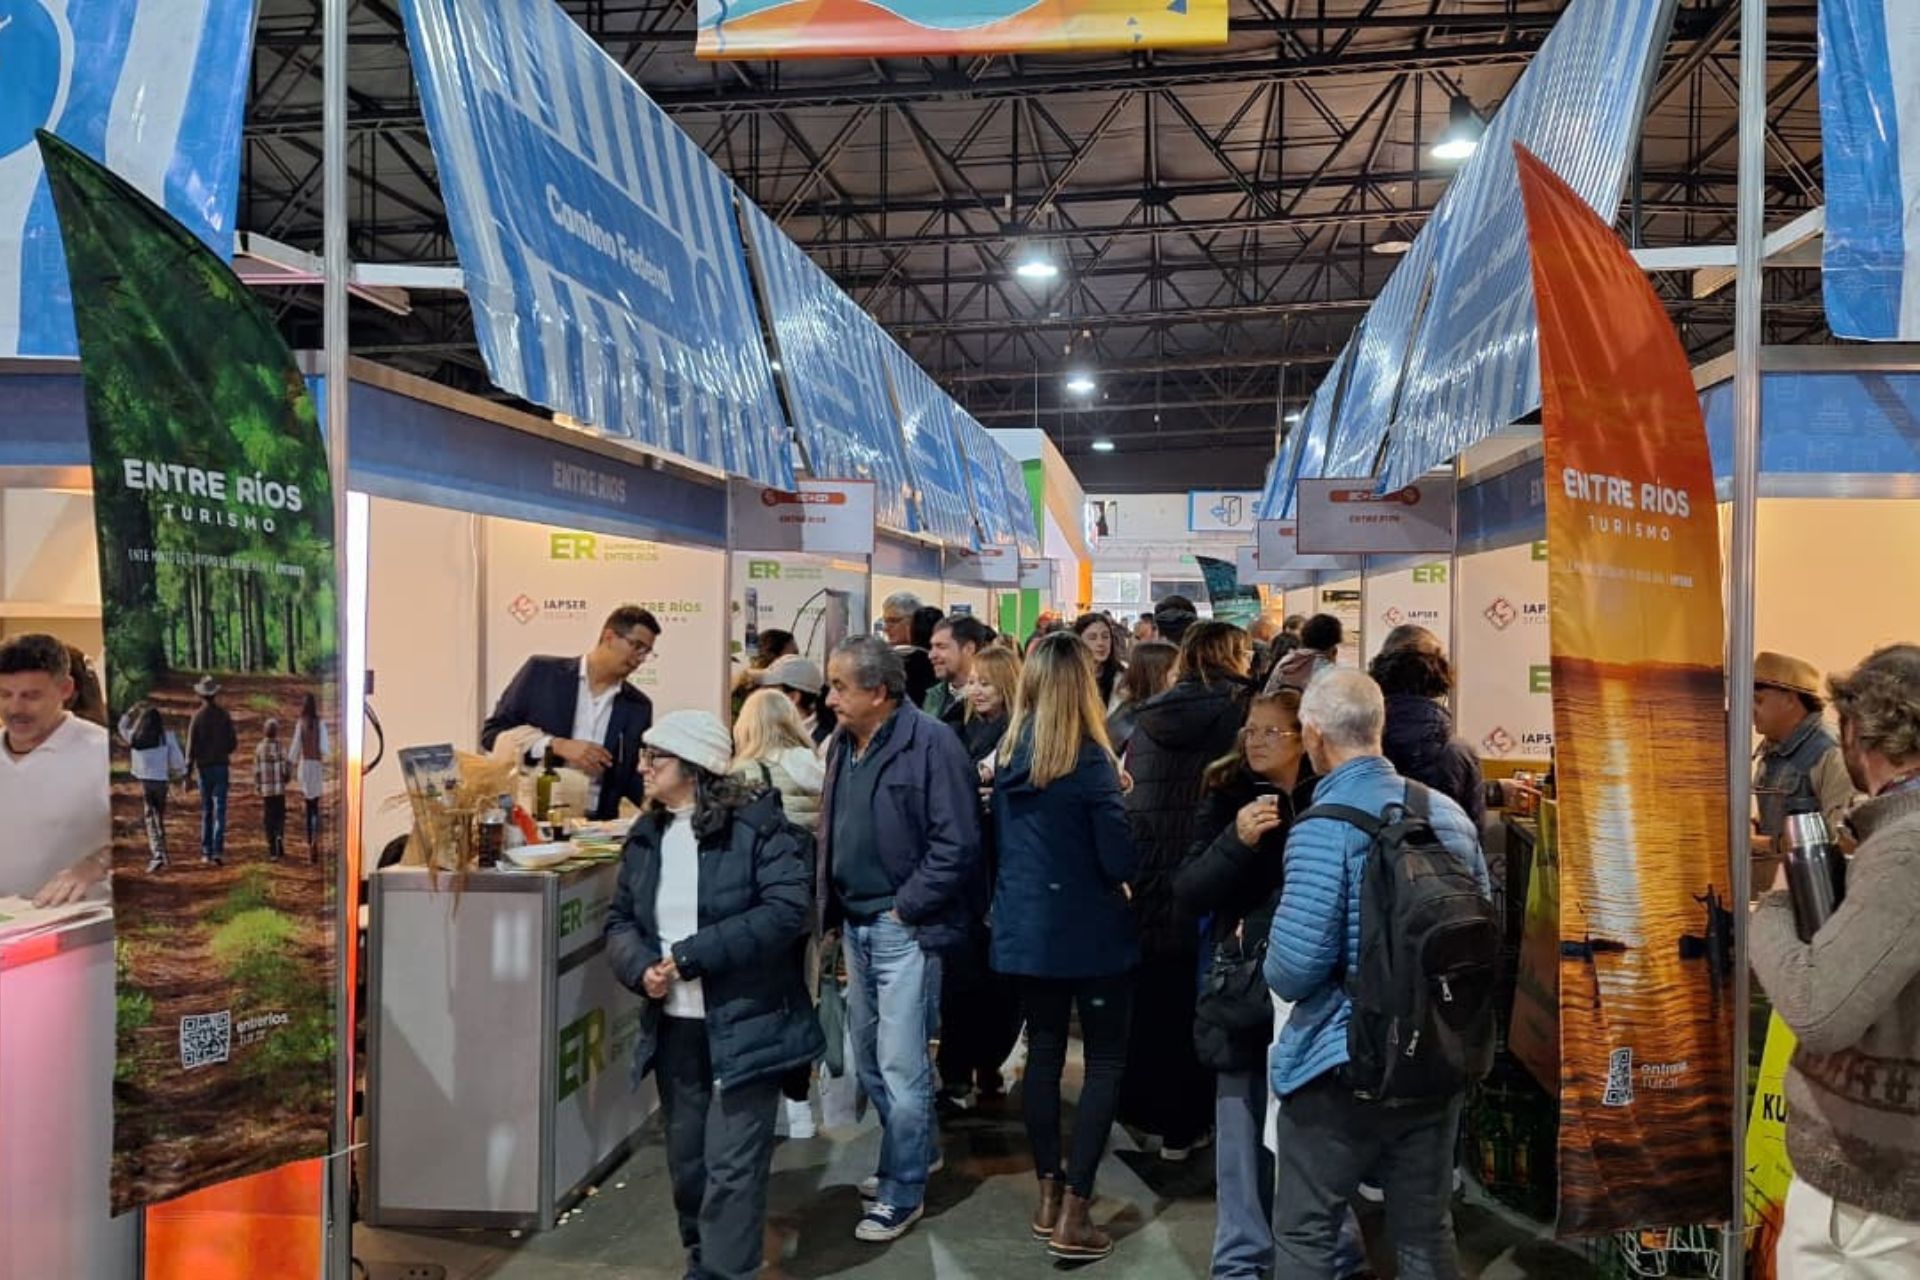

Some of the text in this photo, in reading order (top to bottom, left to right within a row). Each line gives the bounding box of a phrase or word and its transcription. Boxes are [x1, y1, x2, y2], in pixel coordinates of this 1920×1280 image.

[545, 182, 675, 303] Camino Federal
[123, 458, 302, 513] ENTRE RÍOS
[553, 460, 597, 497] ENTRE
[1563, 467, 1635, 510] ENTRE
[1641, 475, 1690, 518] RÍOS
[163, 503, 276, 533] TURISMO
[1588, 514, 1670, 541] TURISMO
[551, 533, 597, 560] ER
[1531, 541, 1549, 561] E
[748, 560, 780, 579] ER
[1412, 564, 1447, 584] ER
[543, 600, 587, 610] IAPSER
[1523, 603, 1548, 614] IAP
[1529, 665, 1551, 694] E
[1522, 733, 1552, 744] IAPS
[560, 898, 583, 939] ER
[558, 1006, 606, 1103] ER
[1763, 1093, 1787, 1123] KU
